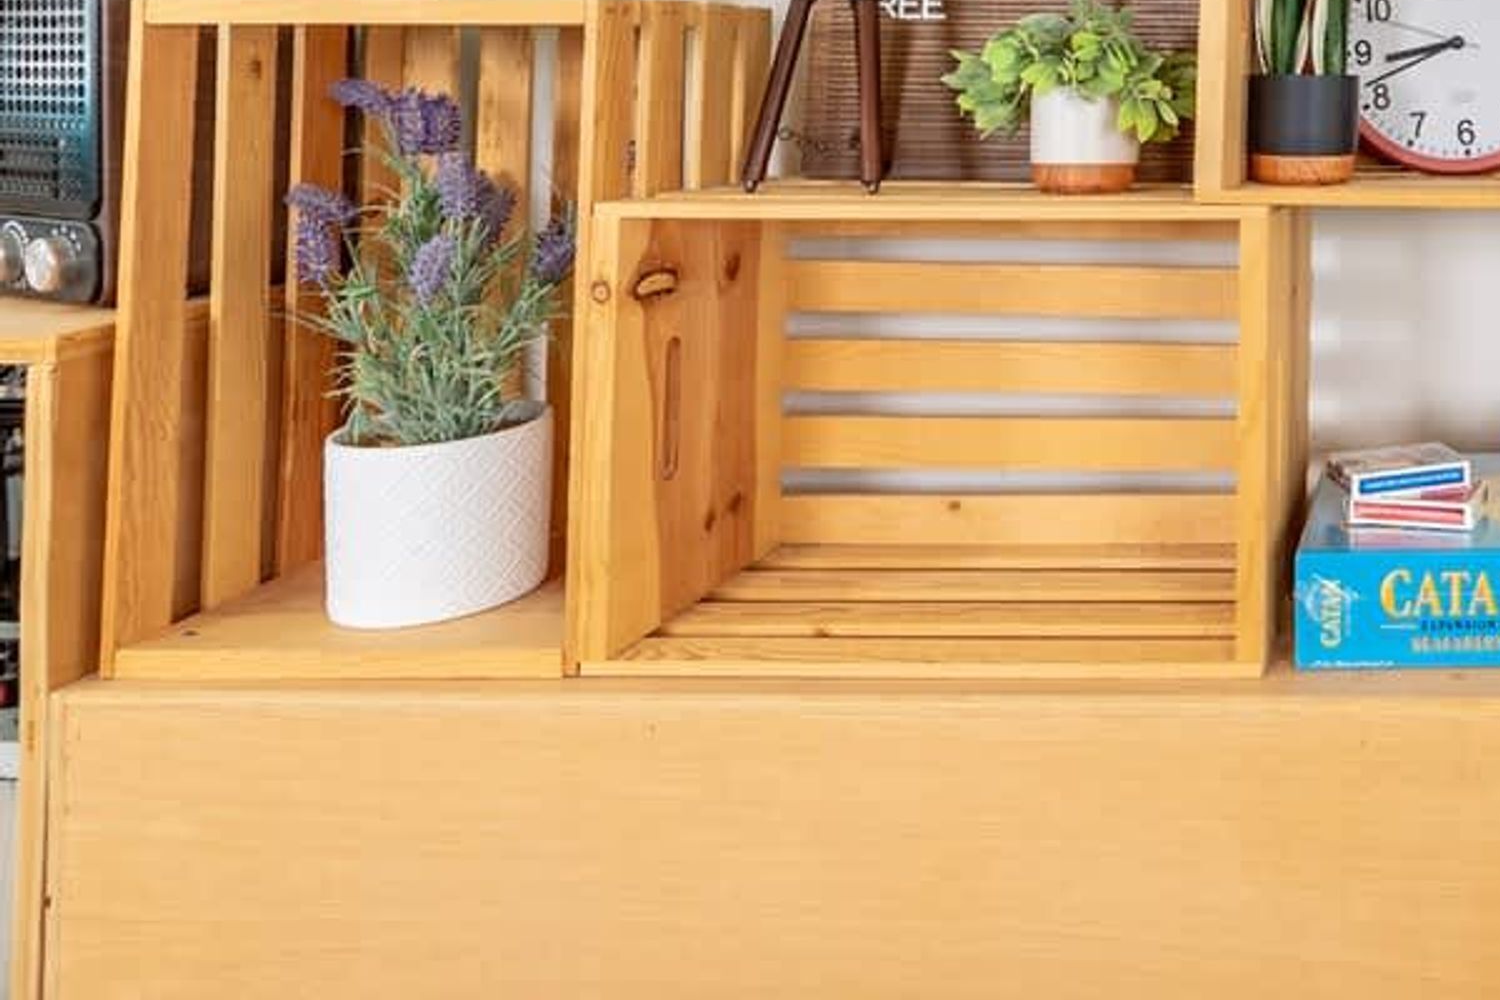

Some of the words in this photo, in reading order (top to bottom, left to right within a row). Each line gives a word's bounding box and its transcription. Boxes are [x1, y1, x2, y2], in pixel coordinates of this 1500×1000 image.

[1354, 39, 1372, 66] 9
[1372, 83, 1390, 110] 8
[1410, 112, 1427, 138] 7
[1457, 119, 1475, 145] 6
